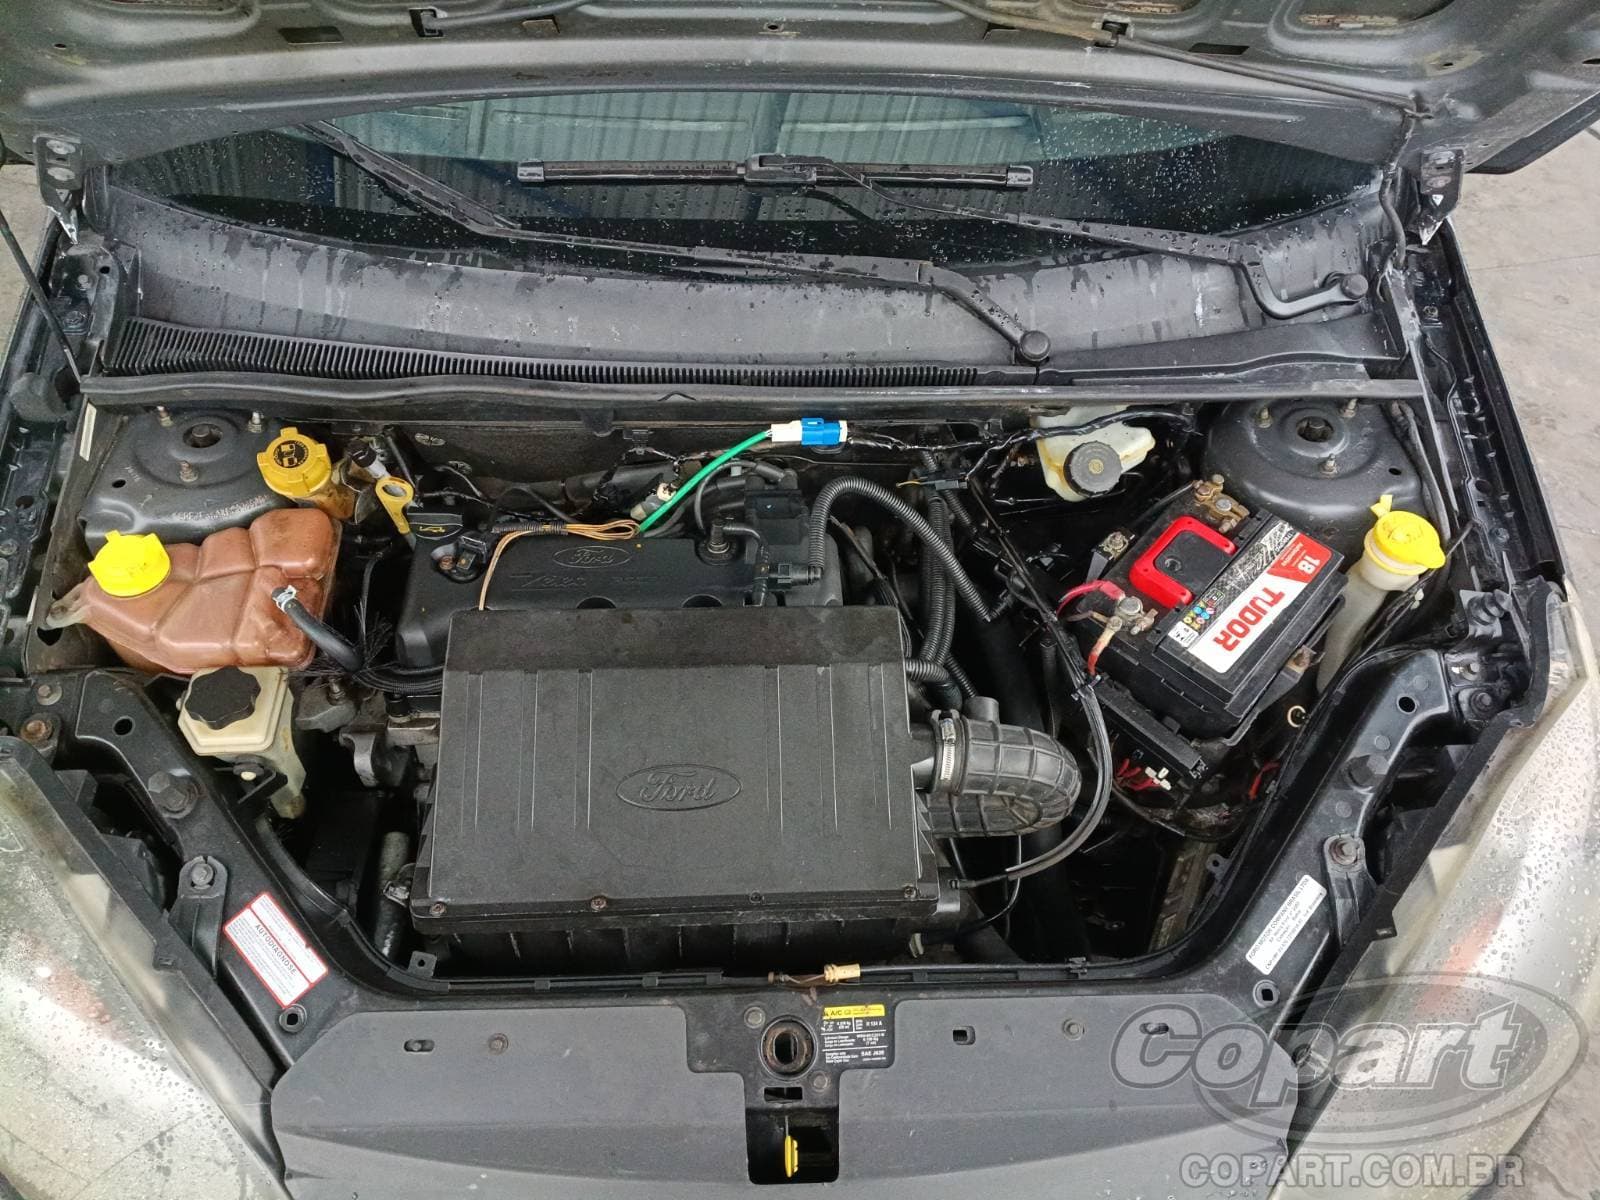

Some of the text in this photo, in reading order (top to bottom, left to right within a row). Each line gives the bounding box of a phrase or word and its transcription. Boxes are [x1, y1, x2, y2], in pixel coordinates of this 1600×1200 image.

[568, 549, 615, 564] Ford
[1297, 554, 1321, 575] 18
[1213, 587, 1285, 651] TUDOR
[639, 770, 717, 802] Ford
[255, 924, 297, 975] AUTODIAGNOSE
